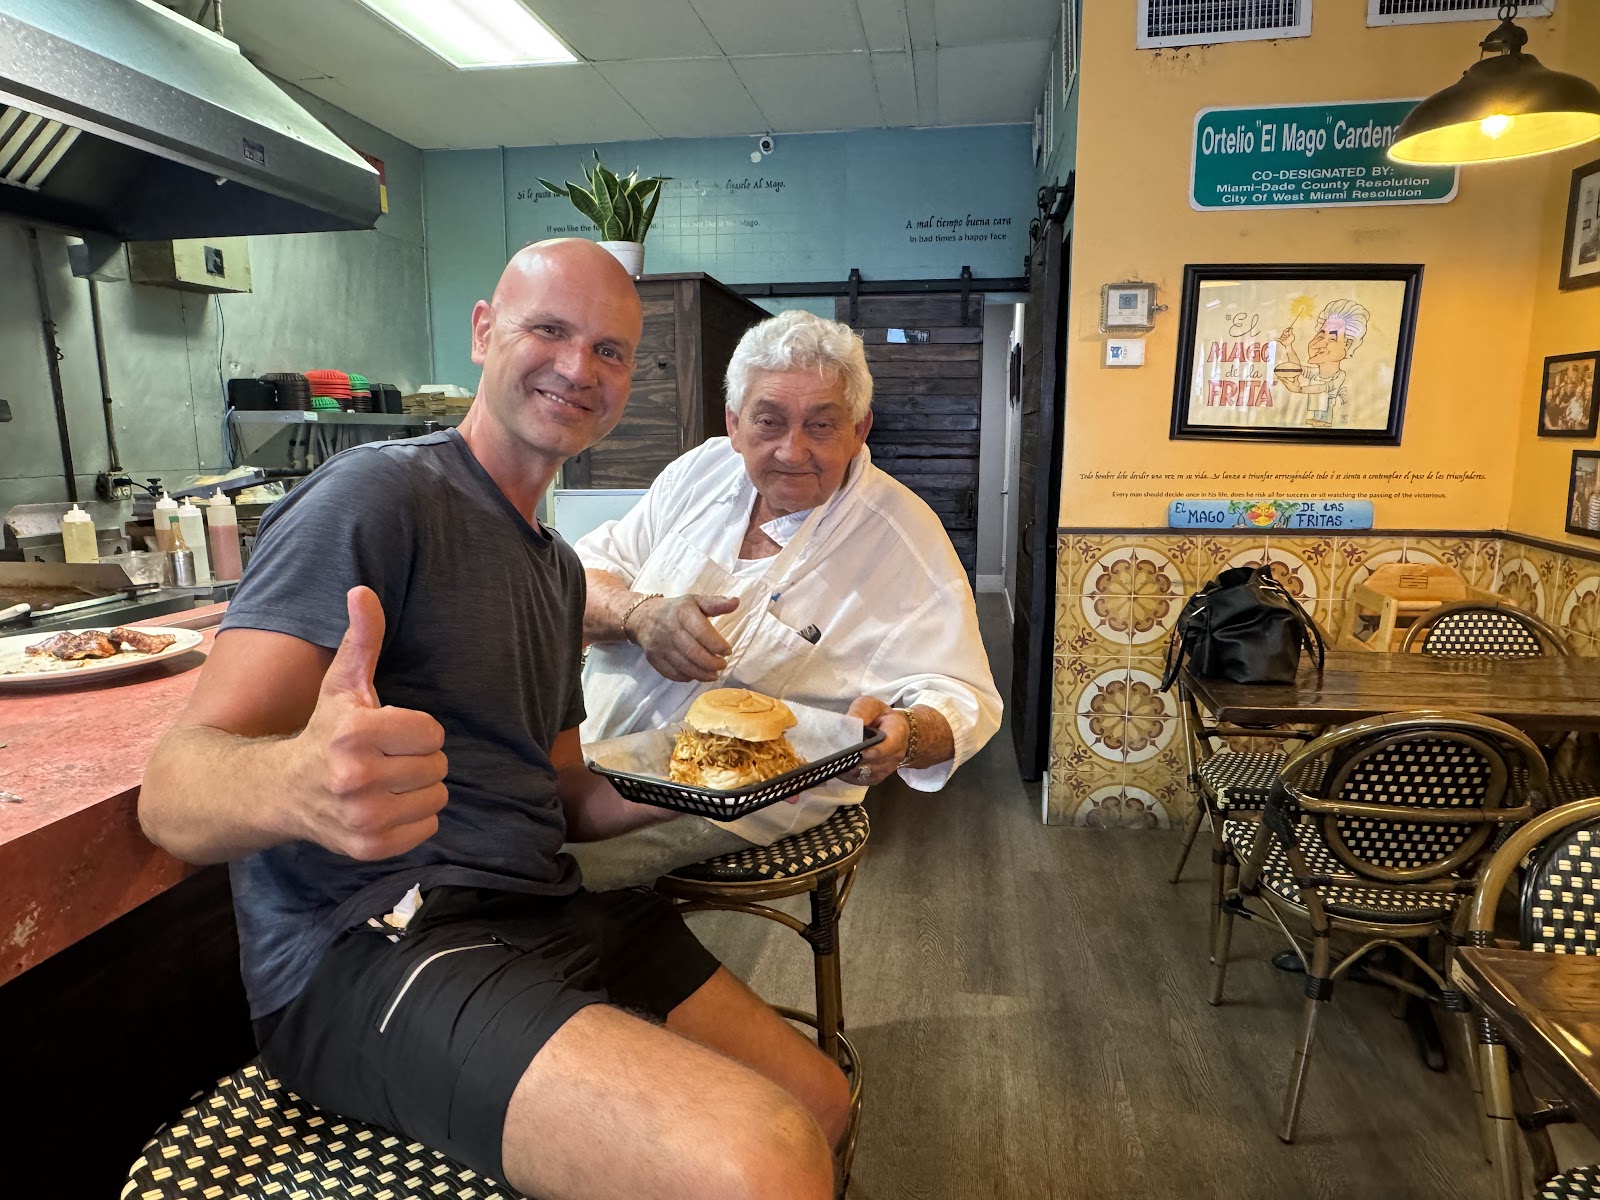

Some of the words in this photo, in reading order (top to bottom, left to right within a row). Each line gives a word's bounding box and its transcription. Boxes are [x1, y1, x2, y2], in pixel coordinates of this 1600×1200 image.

[1202, 125, 1255, 155] Ortelio
[1252, 167, 1366, 181] CO-DESIGNATED
[1372, 166, 1394, 177] BY:
[765, 180, 786, 193] Mago.
[1216, 182, 1296, 193] Miami-Dade
[1301, 180, 1350, 190] County
[1356, 177, 1430, 188] Resolution
[1222, 194, 1247, 204] City
[1252, 193, 1268, 202] Of
[1273, 192, 1304, 202] West
[1309, 190, 1347, 200] Miami
[1352, 188, 1422, 199] Resolution
[553, 226, 566, 234] you
[567, 224, 579, 232] like
[580, 224, 592, 232] the
[905, 219, 913, 229] A
[916, 215, 935, 229] mal
[936, 217, 963, 233] tiempo
[965, 213, 990, 228] buena
[993, 217, 1012, 227] cara
[918, 234, 933, 243] bad
[935, 234, 957, 242] times
[964, 232, 988, 242] happy
[990, 231, 1007, 240] face
[1225, 364, 1239, 378] de
[1245, 364, 1263, 379] la
[1080, 471, 1094, 480] Todo
[1095, 471, 1115, 480] hombre
[1116, 471, 1129, 480] debe
[1130, 471, 1150, 480] decidir
[1222, 471, 1241, 480] lanza
[1248, 471, 1273, 482] triunfar
[1316, 471, 1329, 480] todo
[1342, 472, 1361, 480] sienta
[1368, 471, 1402, 483] contemplar
[1403, 471, 1411, 480] el
[1410, 474, 1424, 483] paso
[1426, 471, 1434, 480] de
[1435, 471, 1444, 480] los
[1327, 491, 1355, 499] watching
[1301, 503, 1316, 512] DE
[1323, 502, 1345, 512] LAS
[1188, 509, 1225, 524] MAGO
